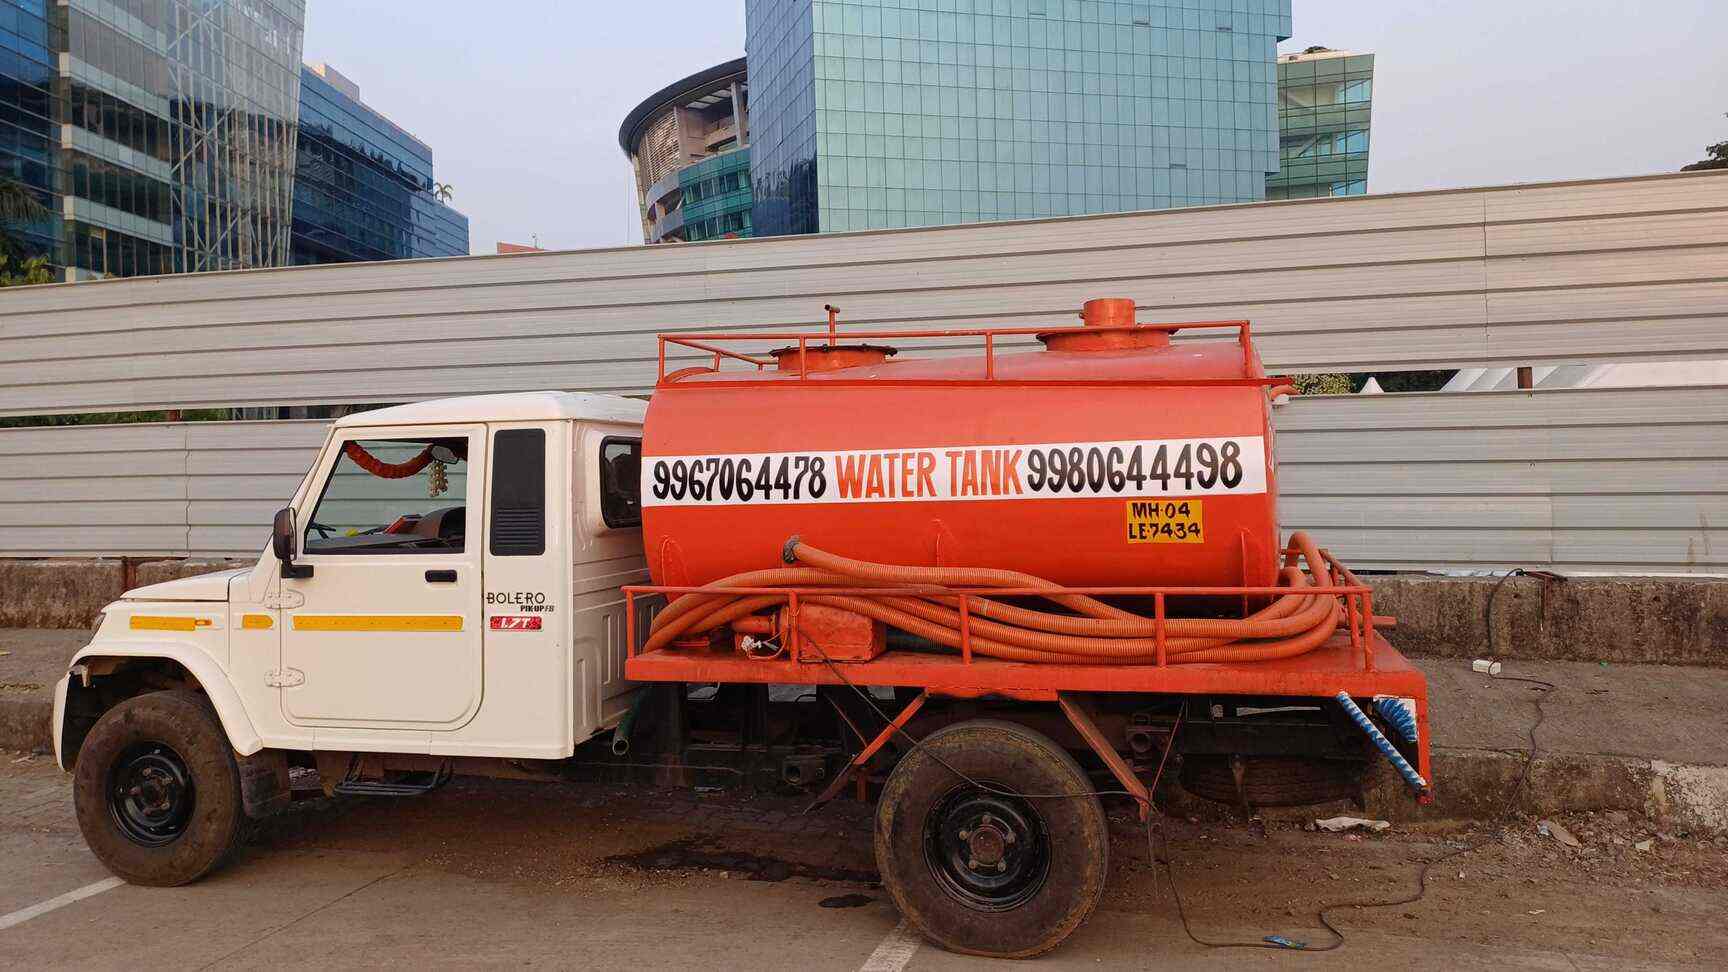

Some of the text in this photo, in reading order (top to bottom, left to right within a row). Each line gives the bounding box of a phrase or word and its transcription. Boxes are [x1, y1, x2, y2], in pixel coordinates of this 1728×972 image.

[652, 440, 1243, 501] 9967064478 WATER TANK 9980644498
[486, 592, 546, 605] BOLERO
